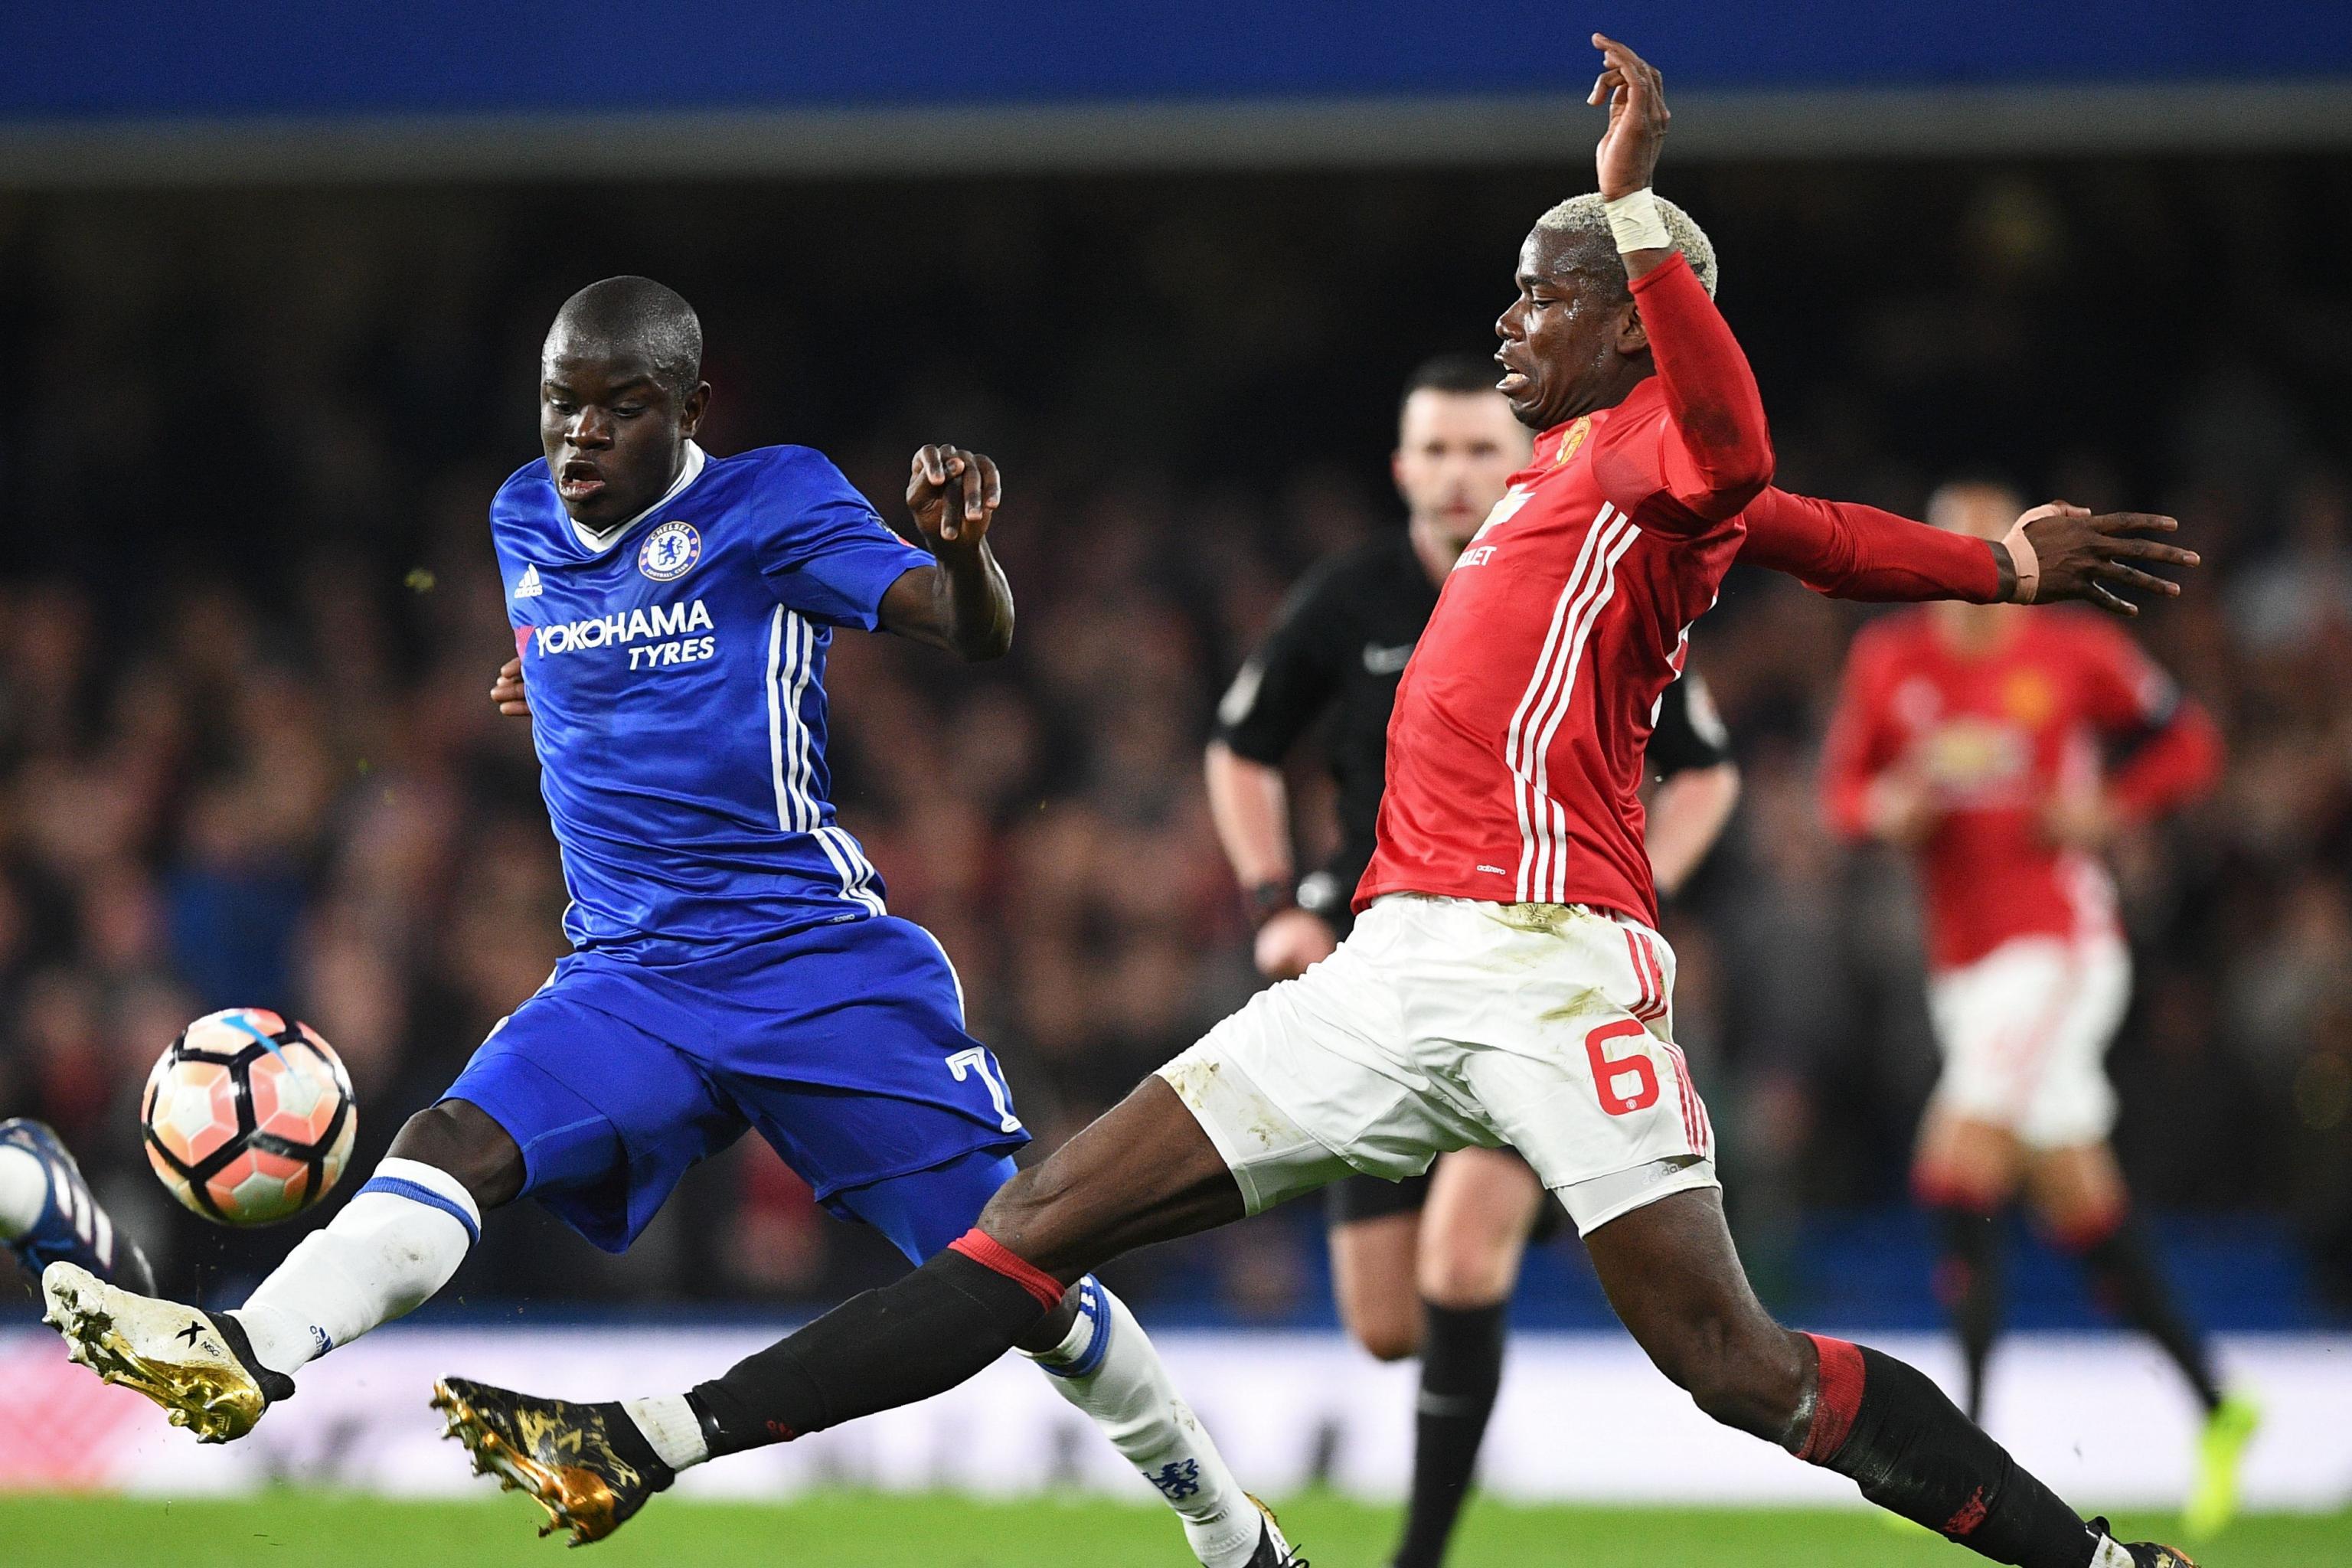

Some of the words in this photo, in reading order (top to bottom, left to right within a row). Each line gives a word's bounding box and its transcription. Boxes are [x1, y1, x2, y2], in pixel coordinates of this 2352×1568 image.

[651, 523, 691, 541] CHELSEA
[645, 568, 673, 578] FOOTBALL
[514, 583, 543, 599] adidas
[535, 599, 714, 658] YOKOHAMA
[629, 636, 716, 671] TYRES
[1585, 1018, 1660, 1116] 6
[945, 1046, 1023, 1133] 7
[201, 1341, 220, 1357] NSG
